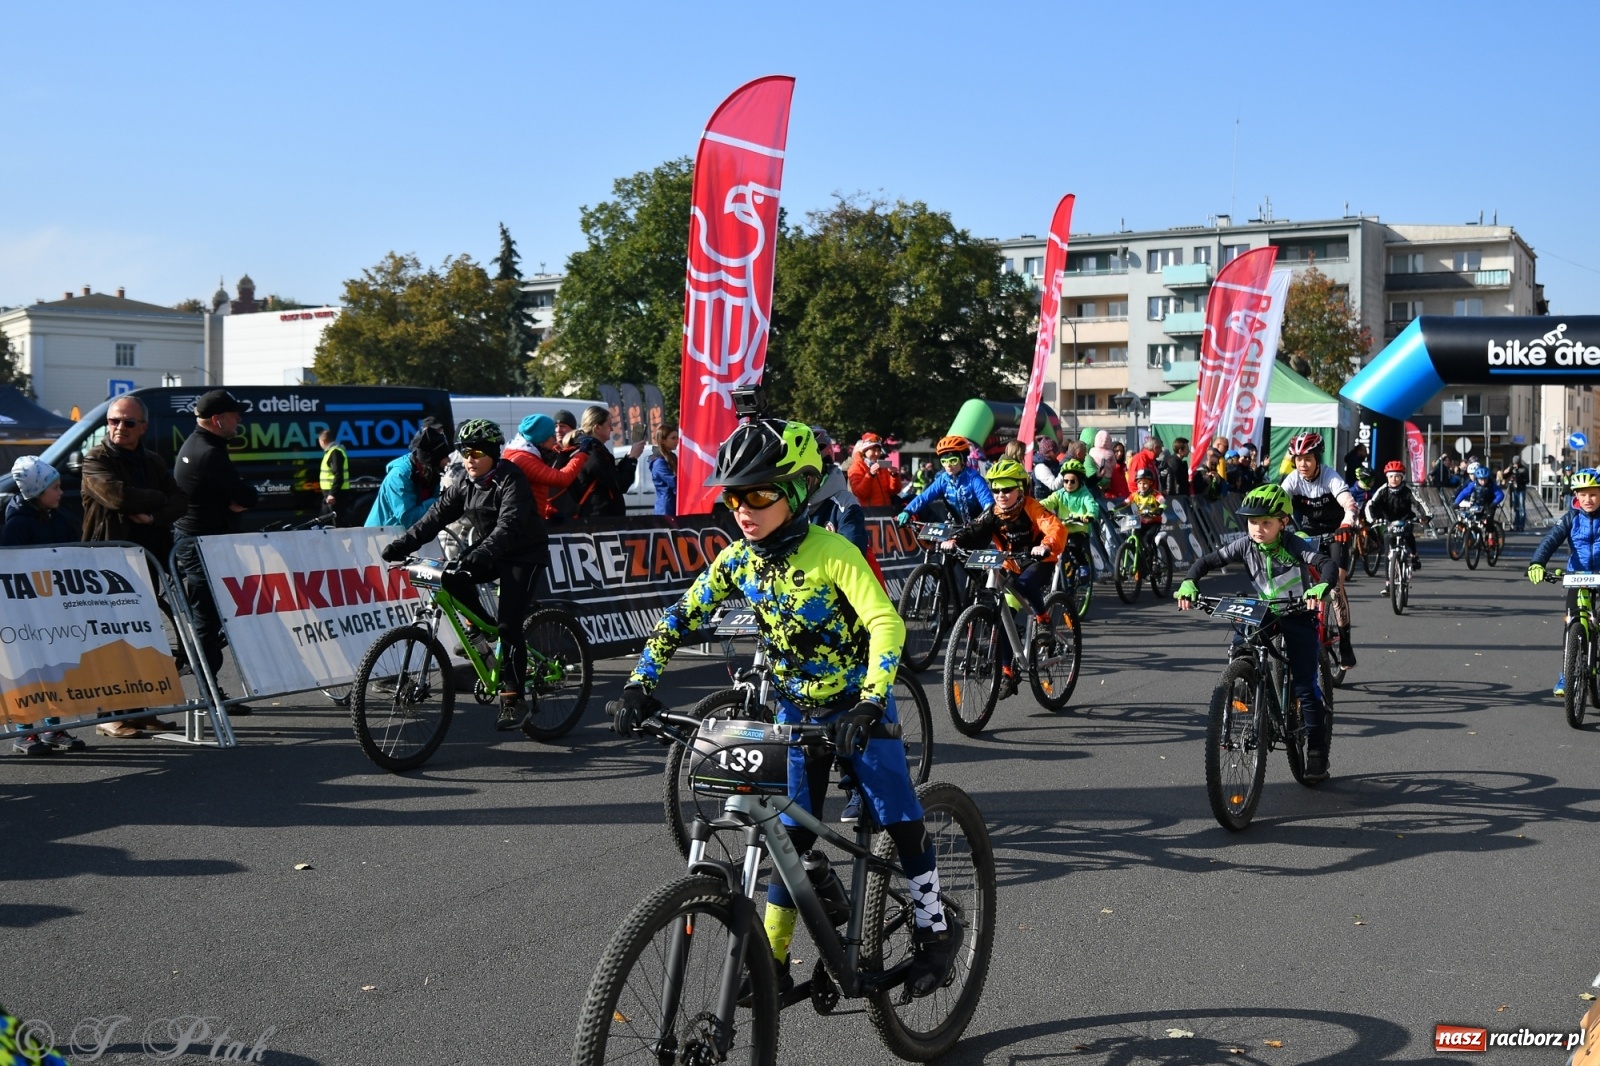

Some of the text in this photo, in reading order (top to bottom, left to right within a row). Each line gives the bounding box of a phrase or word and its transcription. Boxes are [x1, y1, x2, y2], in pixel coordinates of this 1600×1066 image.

[1488, 339, 1547, 366] bike
[258, 395, 319, 413] atelier
[927, 527, 944, 536] 144
[977, 554, 997, 563] 191
[0, 568, 104, 600] TAURUS
[221, 564, 421, 618] YAKIMA
[109, 598, 140, 609] jedziesz
[1225, 604, 1254, 615] 222
[292, 618, 339, 647] TAKE
[338, 607, 388, 638] MORE
[575, 607, 666, 645] SZCZELNIAM
[730, 614, 756, 625] 271
[66, 676, 172, 702] taurus.info.pl
[715, 747, 764, 773] 139
[679, 894, 730, 908] MAXXIS
